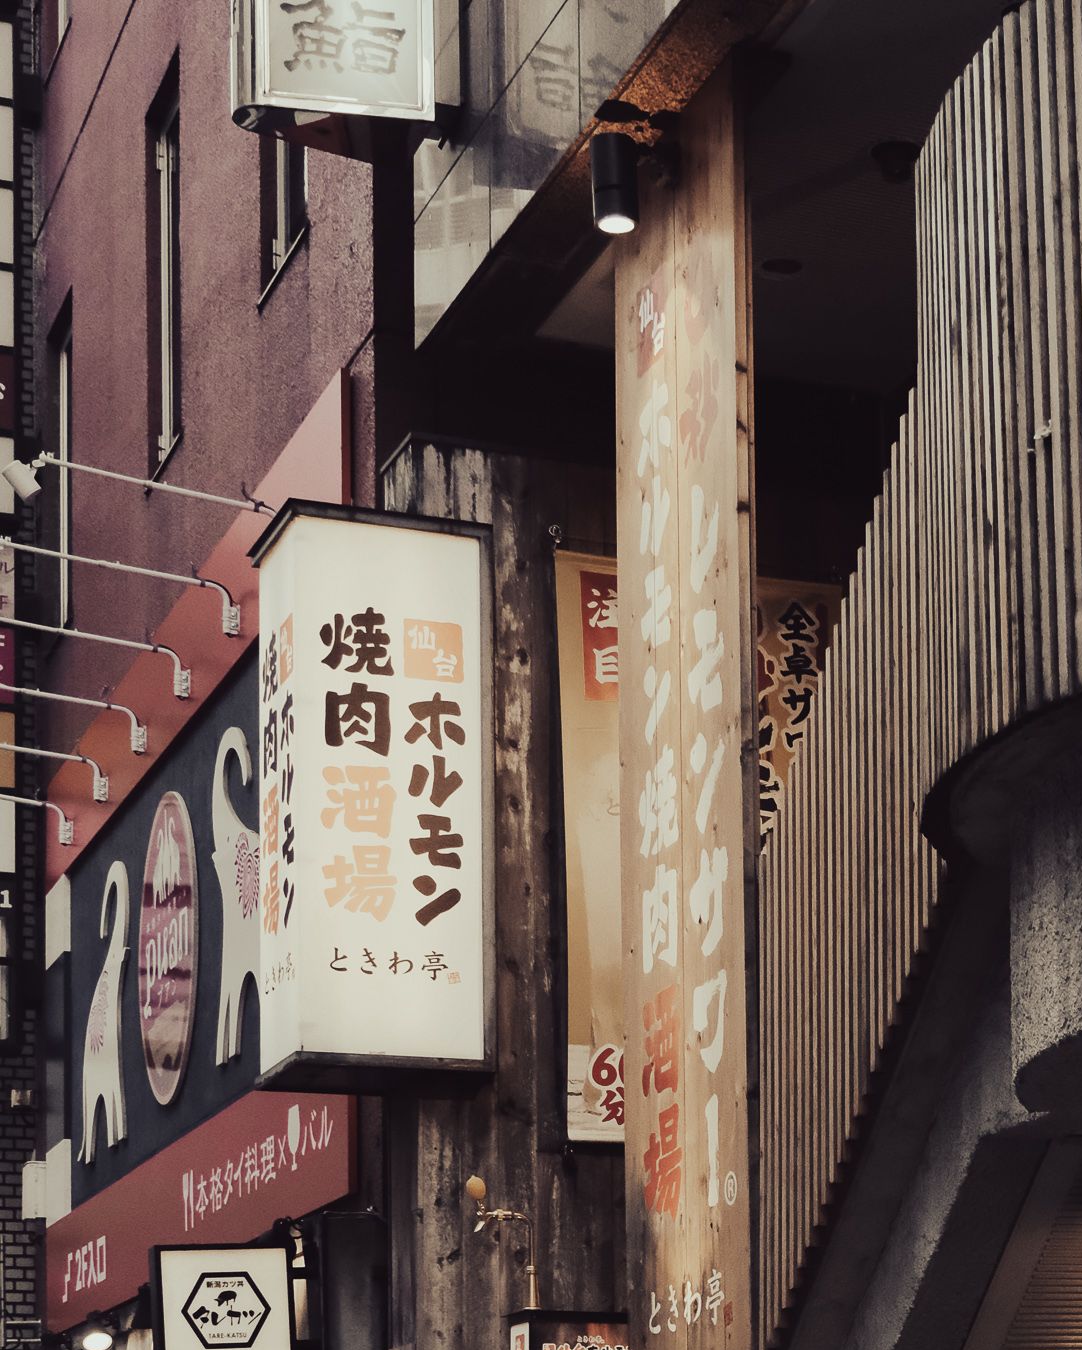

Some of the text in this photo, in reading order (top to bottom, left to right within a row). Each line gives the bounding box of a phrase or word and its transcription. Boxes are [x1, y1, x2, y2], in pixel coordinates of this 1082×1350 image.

[638, 287, 666, 357] 仙台
[407, 624, 458, 680] 仙台
[320, 606, 398, 923] 焼肉酒場
[404, 692, 466, 926] ホルモン
[329, 946, 449, 981] ときわ亭
[591, 1047, 625, 1087] 6
[75, 1235, 107, 1290] 2F入口
[206, 1280, 245, 1289] 新潟カツ丼
[192, 1304, 262, 1329] タレカツ
[649, 1268, 725, 1336] ときわ亭
[208, 1331, 248, 1340] TARE-KATSU
